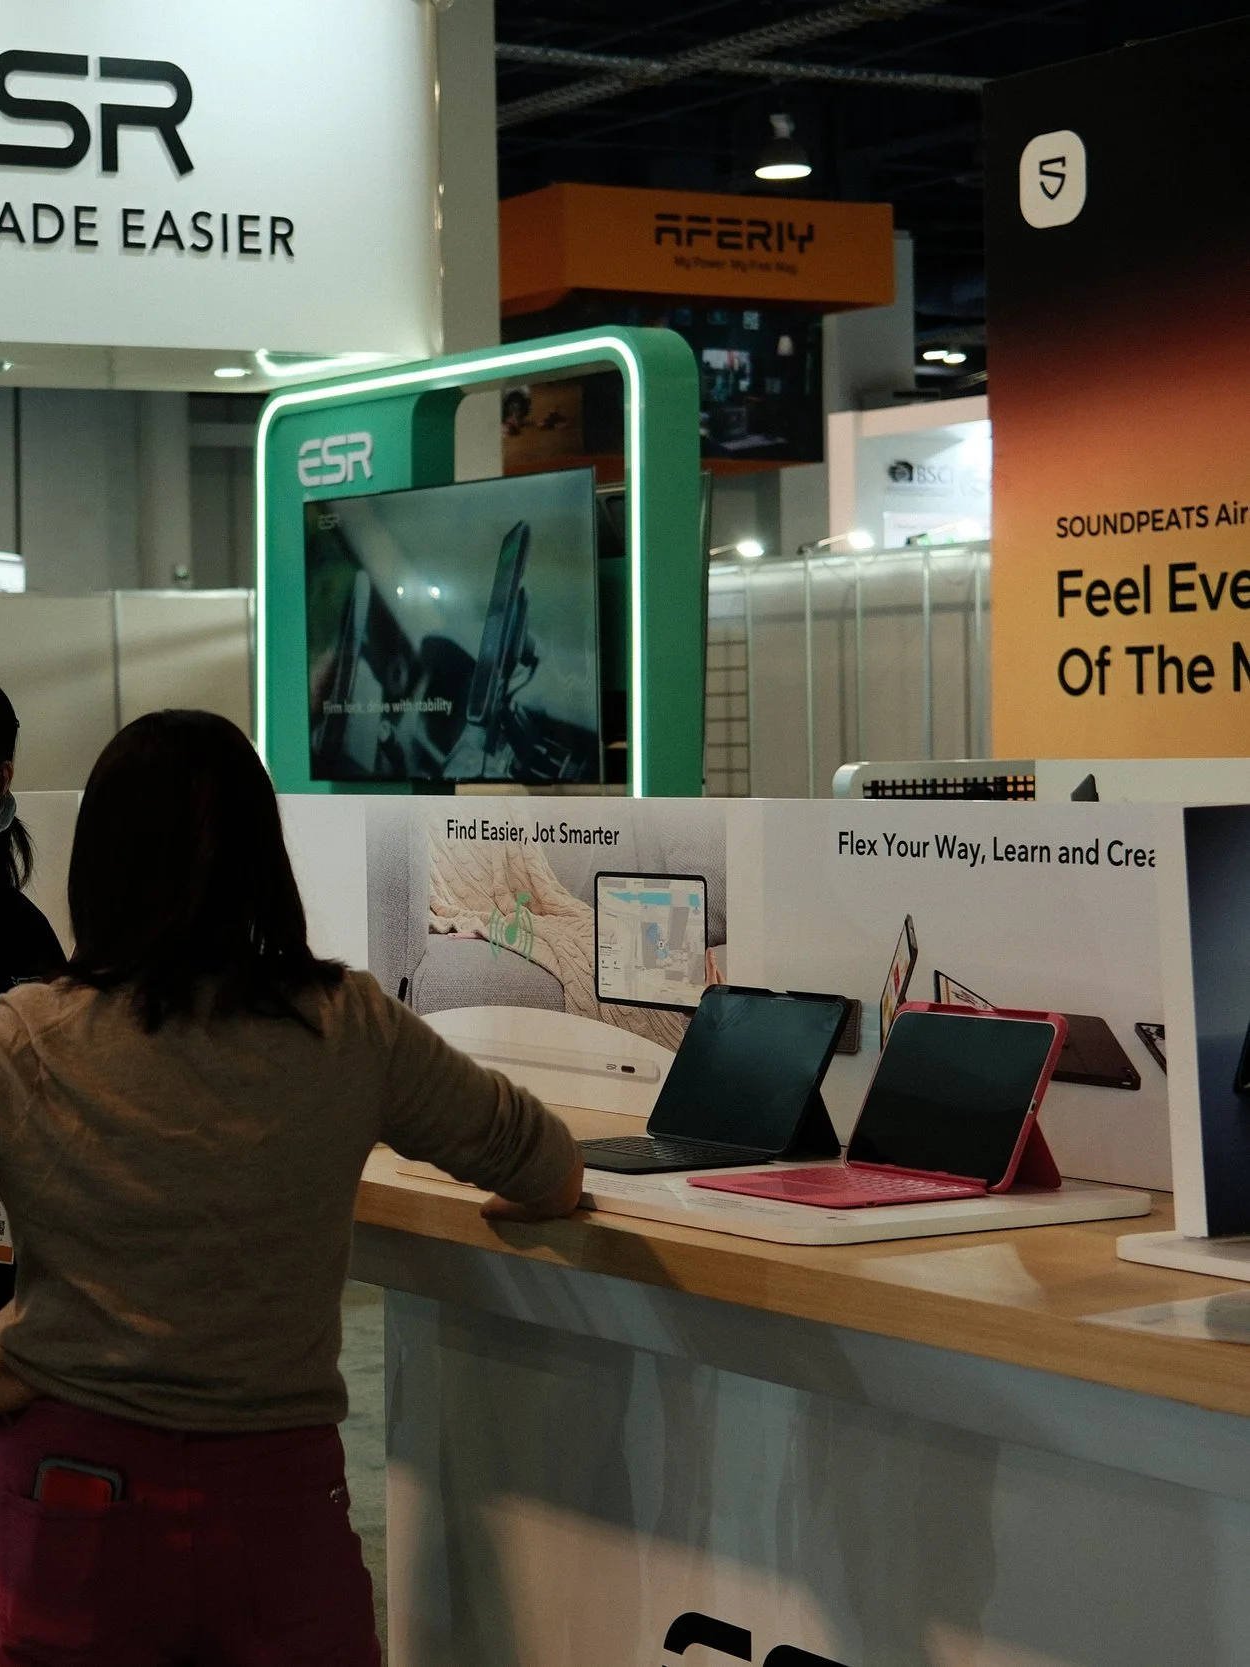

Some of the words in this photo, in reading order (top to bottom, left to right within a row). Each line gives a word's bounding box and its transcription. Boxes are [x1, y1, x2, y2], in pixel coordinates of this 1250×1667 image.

[123, 207, 295, 256] EASIER
[655, 213, 814, 253] AFERIY
[298, 431, 373, 487] ESR
[1056, 505, 1209, 538] SOUNDPEATS
[1215, 501, 1250, 526] Air
[1057, 564, 1150, 618] Feel
[1168, 562, 1250, 613] Eve
[1058, 645, 1111, 697] Of
[1125, 644, 1215, 694] The
[323, 701, 343, 714] Firm
[392, 698, 413, 712] with
[414, 696, 453, 716] stability
[447, 819, 477, 840] Find
[481, 820, 528, 845] Easier,
[532, 821, 555, 844] Jot
[559, 822, 619, 846] Smarter
[838, 831, 878, 856] Flex
[883, 833, 930, 858] Your
[935, 834, 986, 868] Way,
[993, 836, 1050, 863] Learn
[1058, 838, 1100, 866] and
